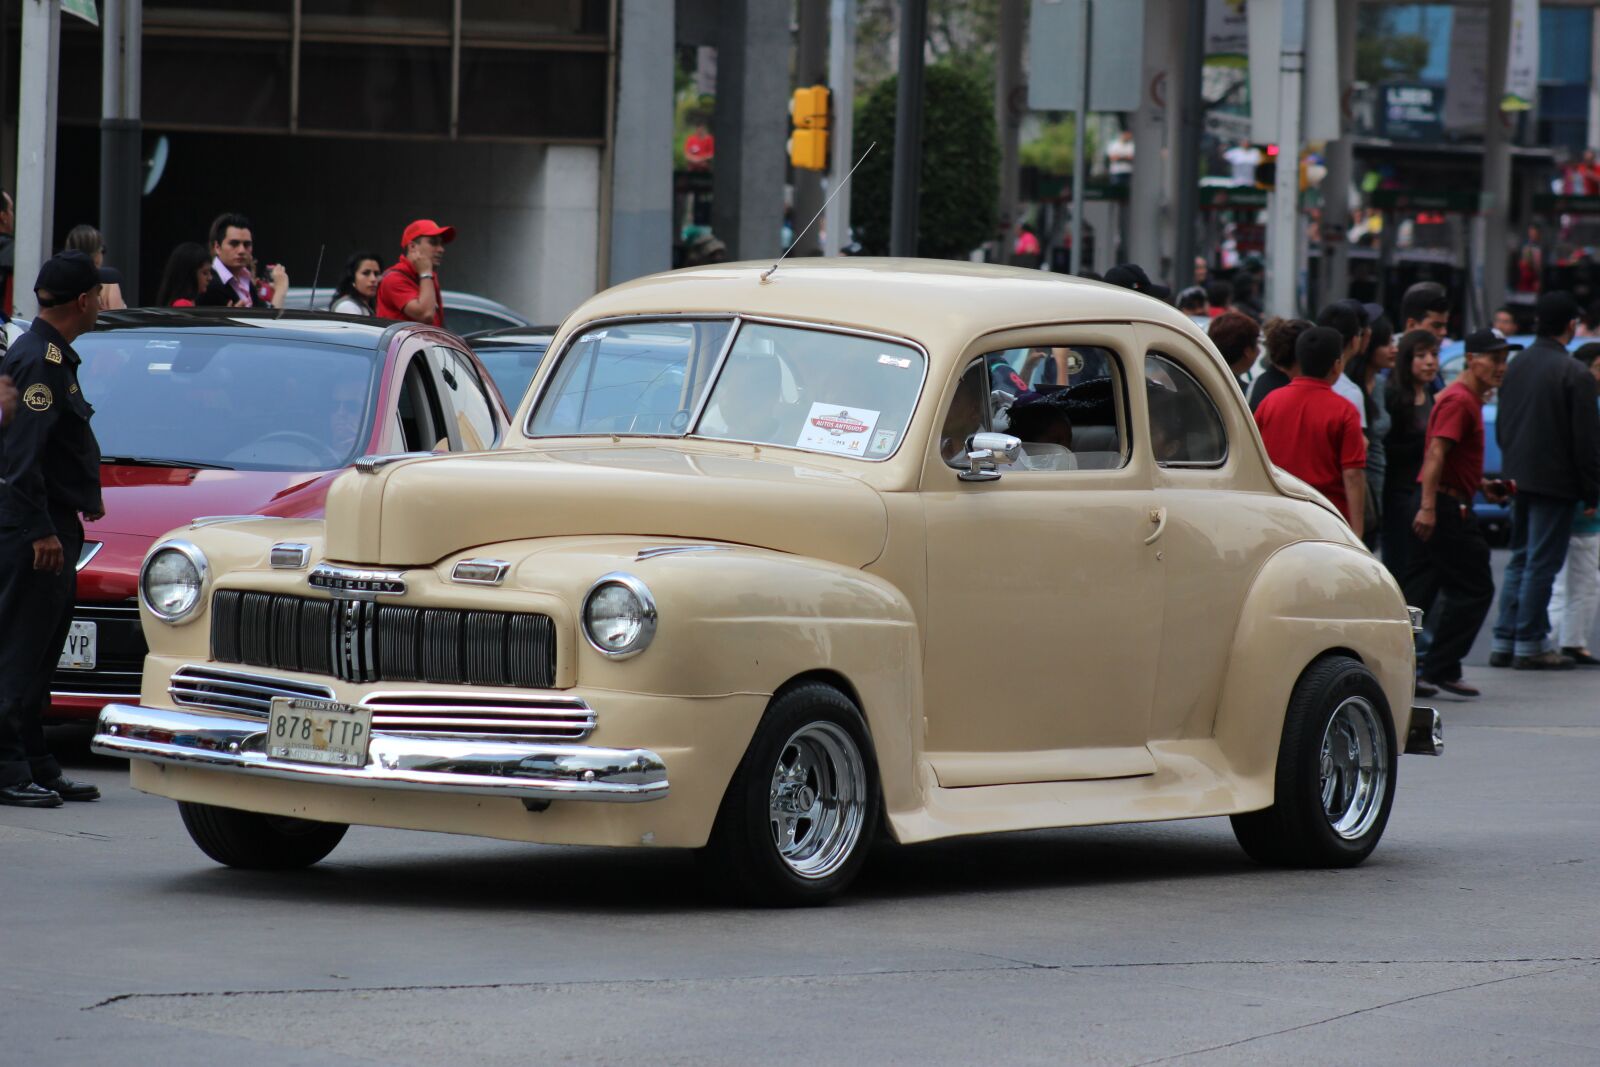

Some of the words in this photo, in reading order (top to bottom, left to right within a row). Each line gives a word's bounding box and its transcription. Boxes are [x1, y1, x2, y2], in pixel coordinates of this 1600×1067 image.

[815, 420, 835, 428] AUTOS
[834, 422, 864, 432] ANTIGUOS
[314, 577, 396, 591] MERCURY
[62, 635, 89, 656] VP
[296, 700, 346, 712] HOUSTON
